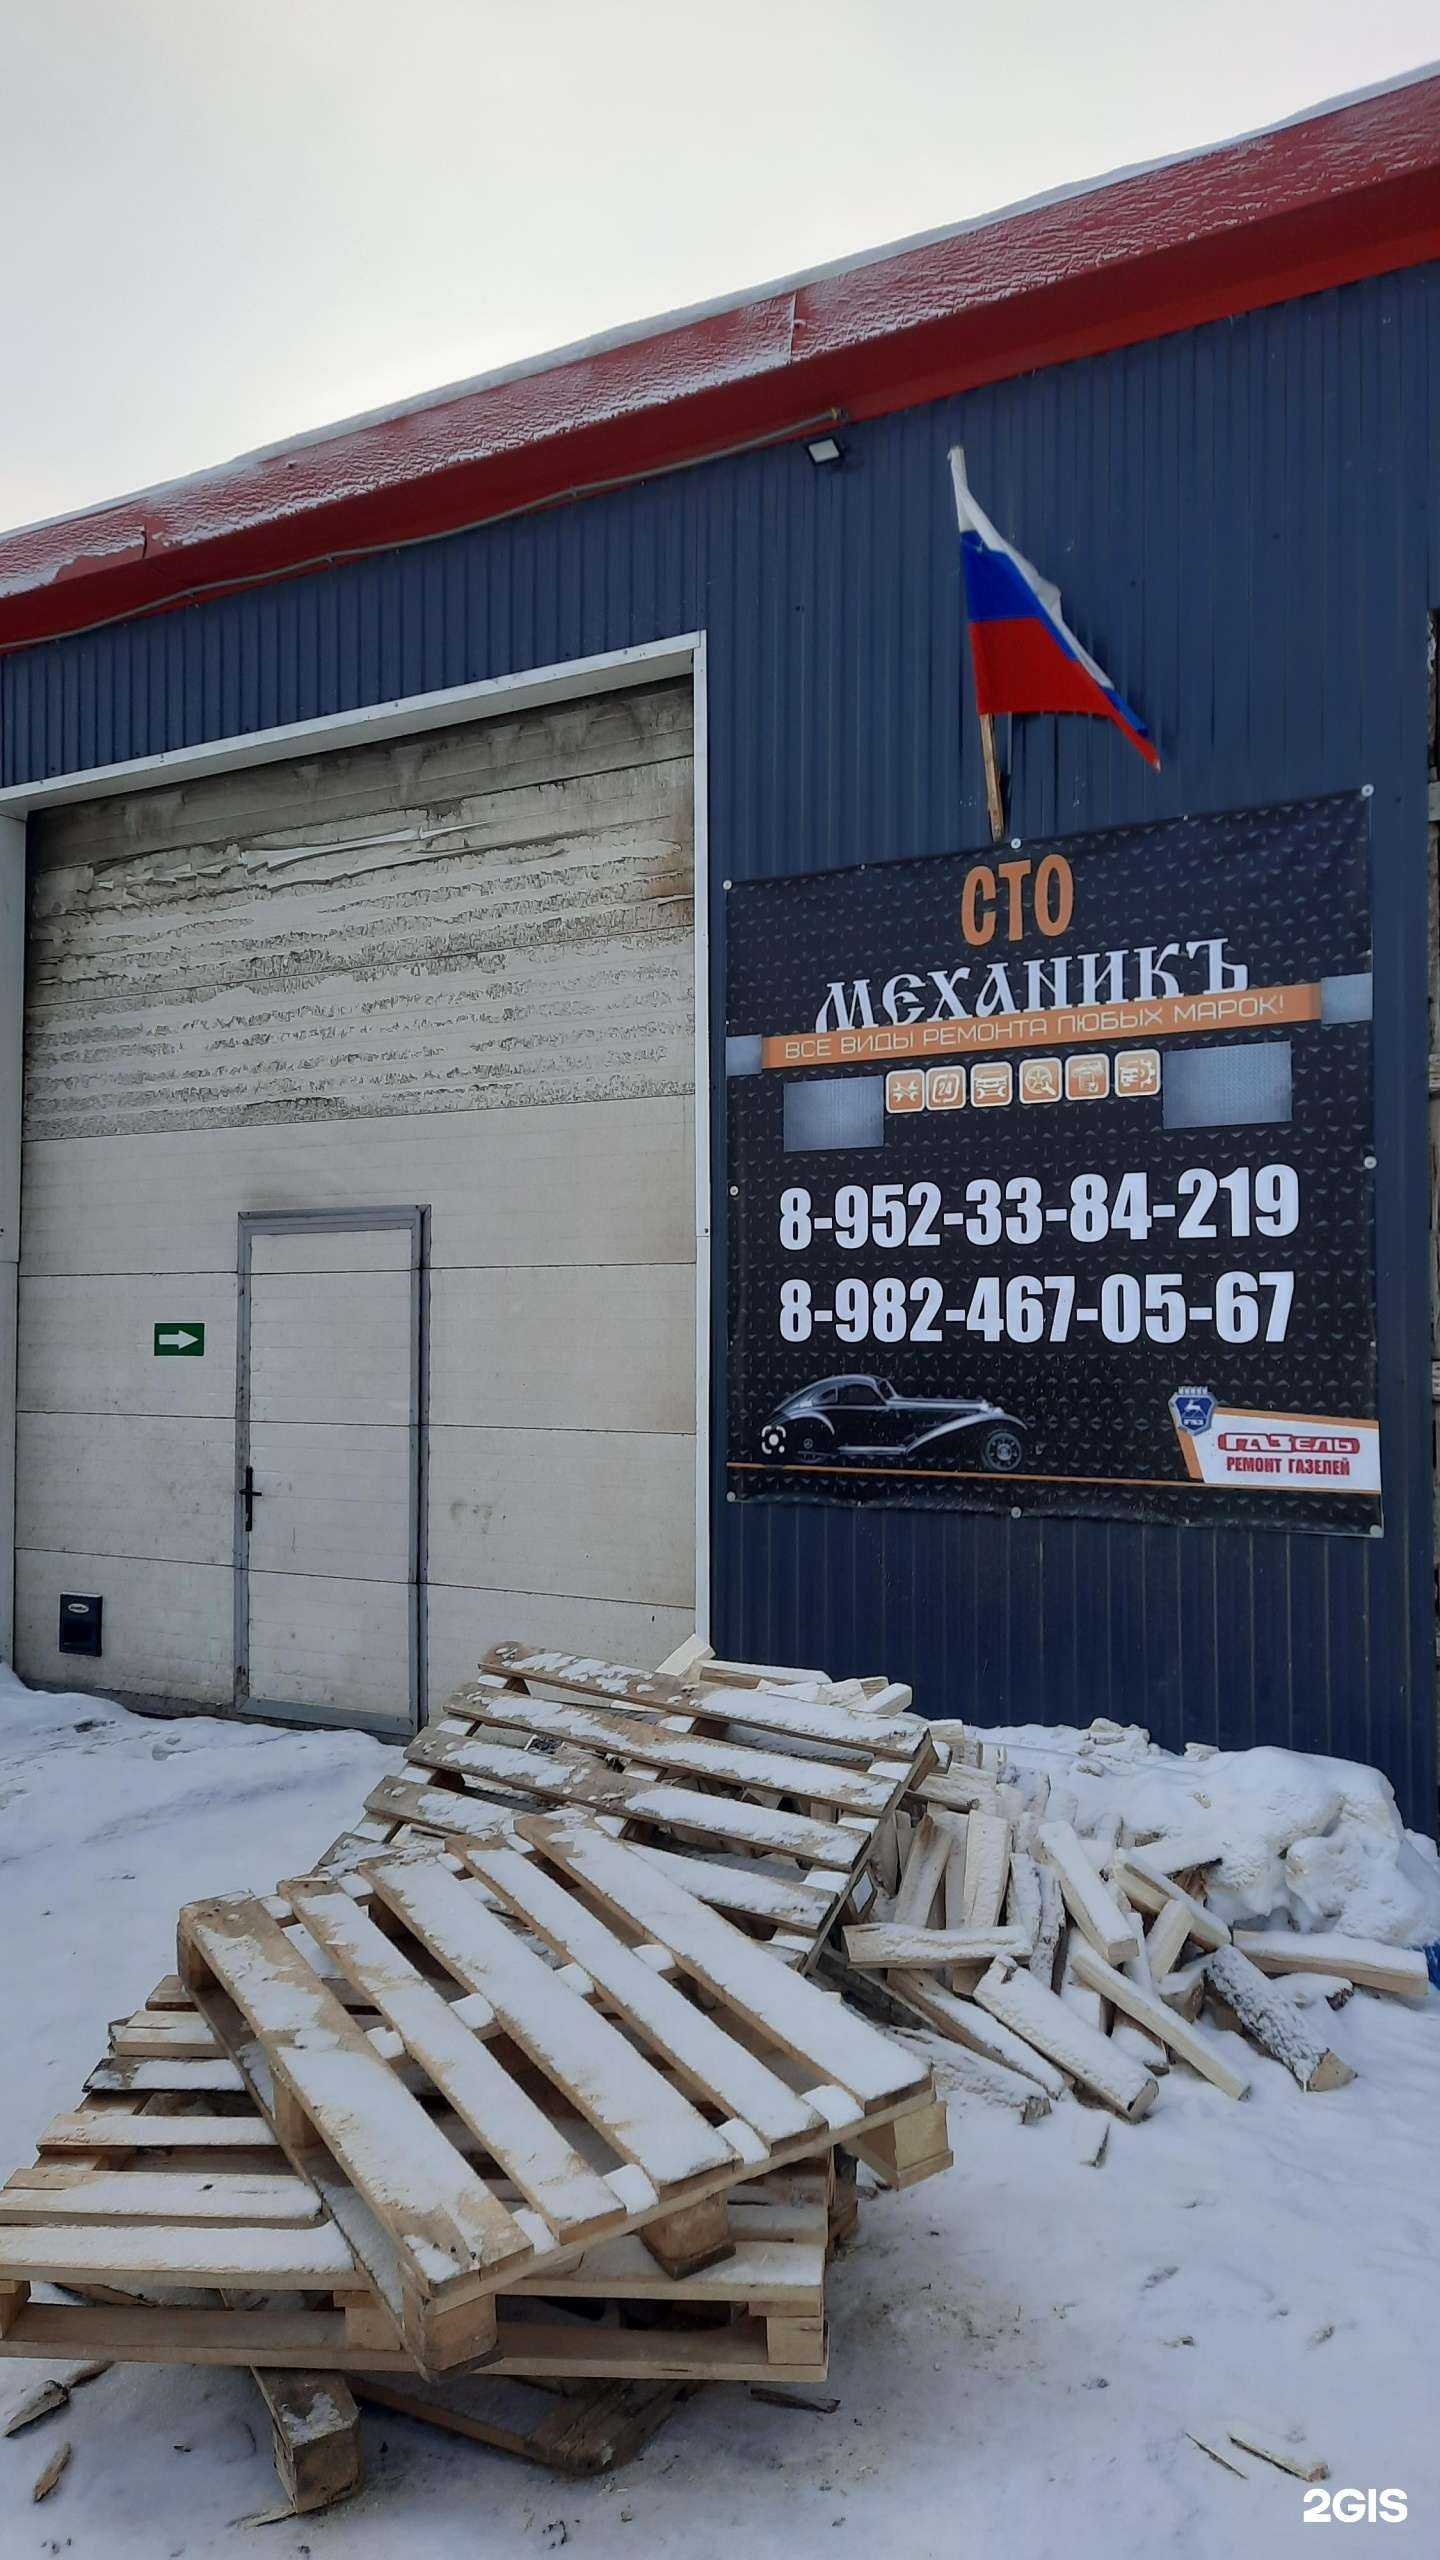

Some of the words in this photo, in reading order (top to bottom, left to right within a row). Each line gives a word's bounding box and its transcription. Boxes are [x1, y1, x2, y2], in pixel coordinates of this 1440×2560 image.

[961, 854, 1074, 946] СТО
[785, 1038, 832, 1060] ВСЕ
[840, 1032, 914, 1055] ВИДЫ
[923, 1018, 1047, 1047] РЕМОНТА
[1057, 1007, 1163, 1035] ЛЮБЫХ
[1173, 995, 1285, 1024] МАРОК!
[778, 1163, 1301, 1250] 8-952-33-84-219
[778, 1270, 1296, 1343] 8-982-467-05-67
[1226, 1434, 1353, 1450] ГАЗЕЛЬ
[1226, 1456, 1282, 1473] РЕМОНТ
[1288, 1457, 1350, 1475] ГАЗЕЛЕЙ
